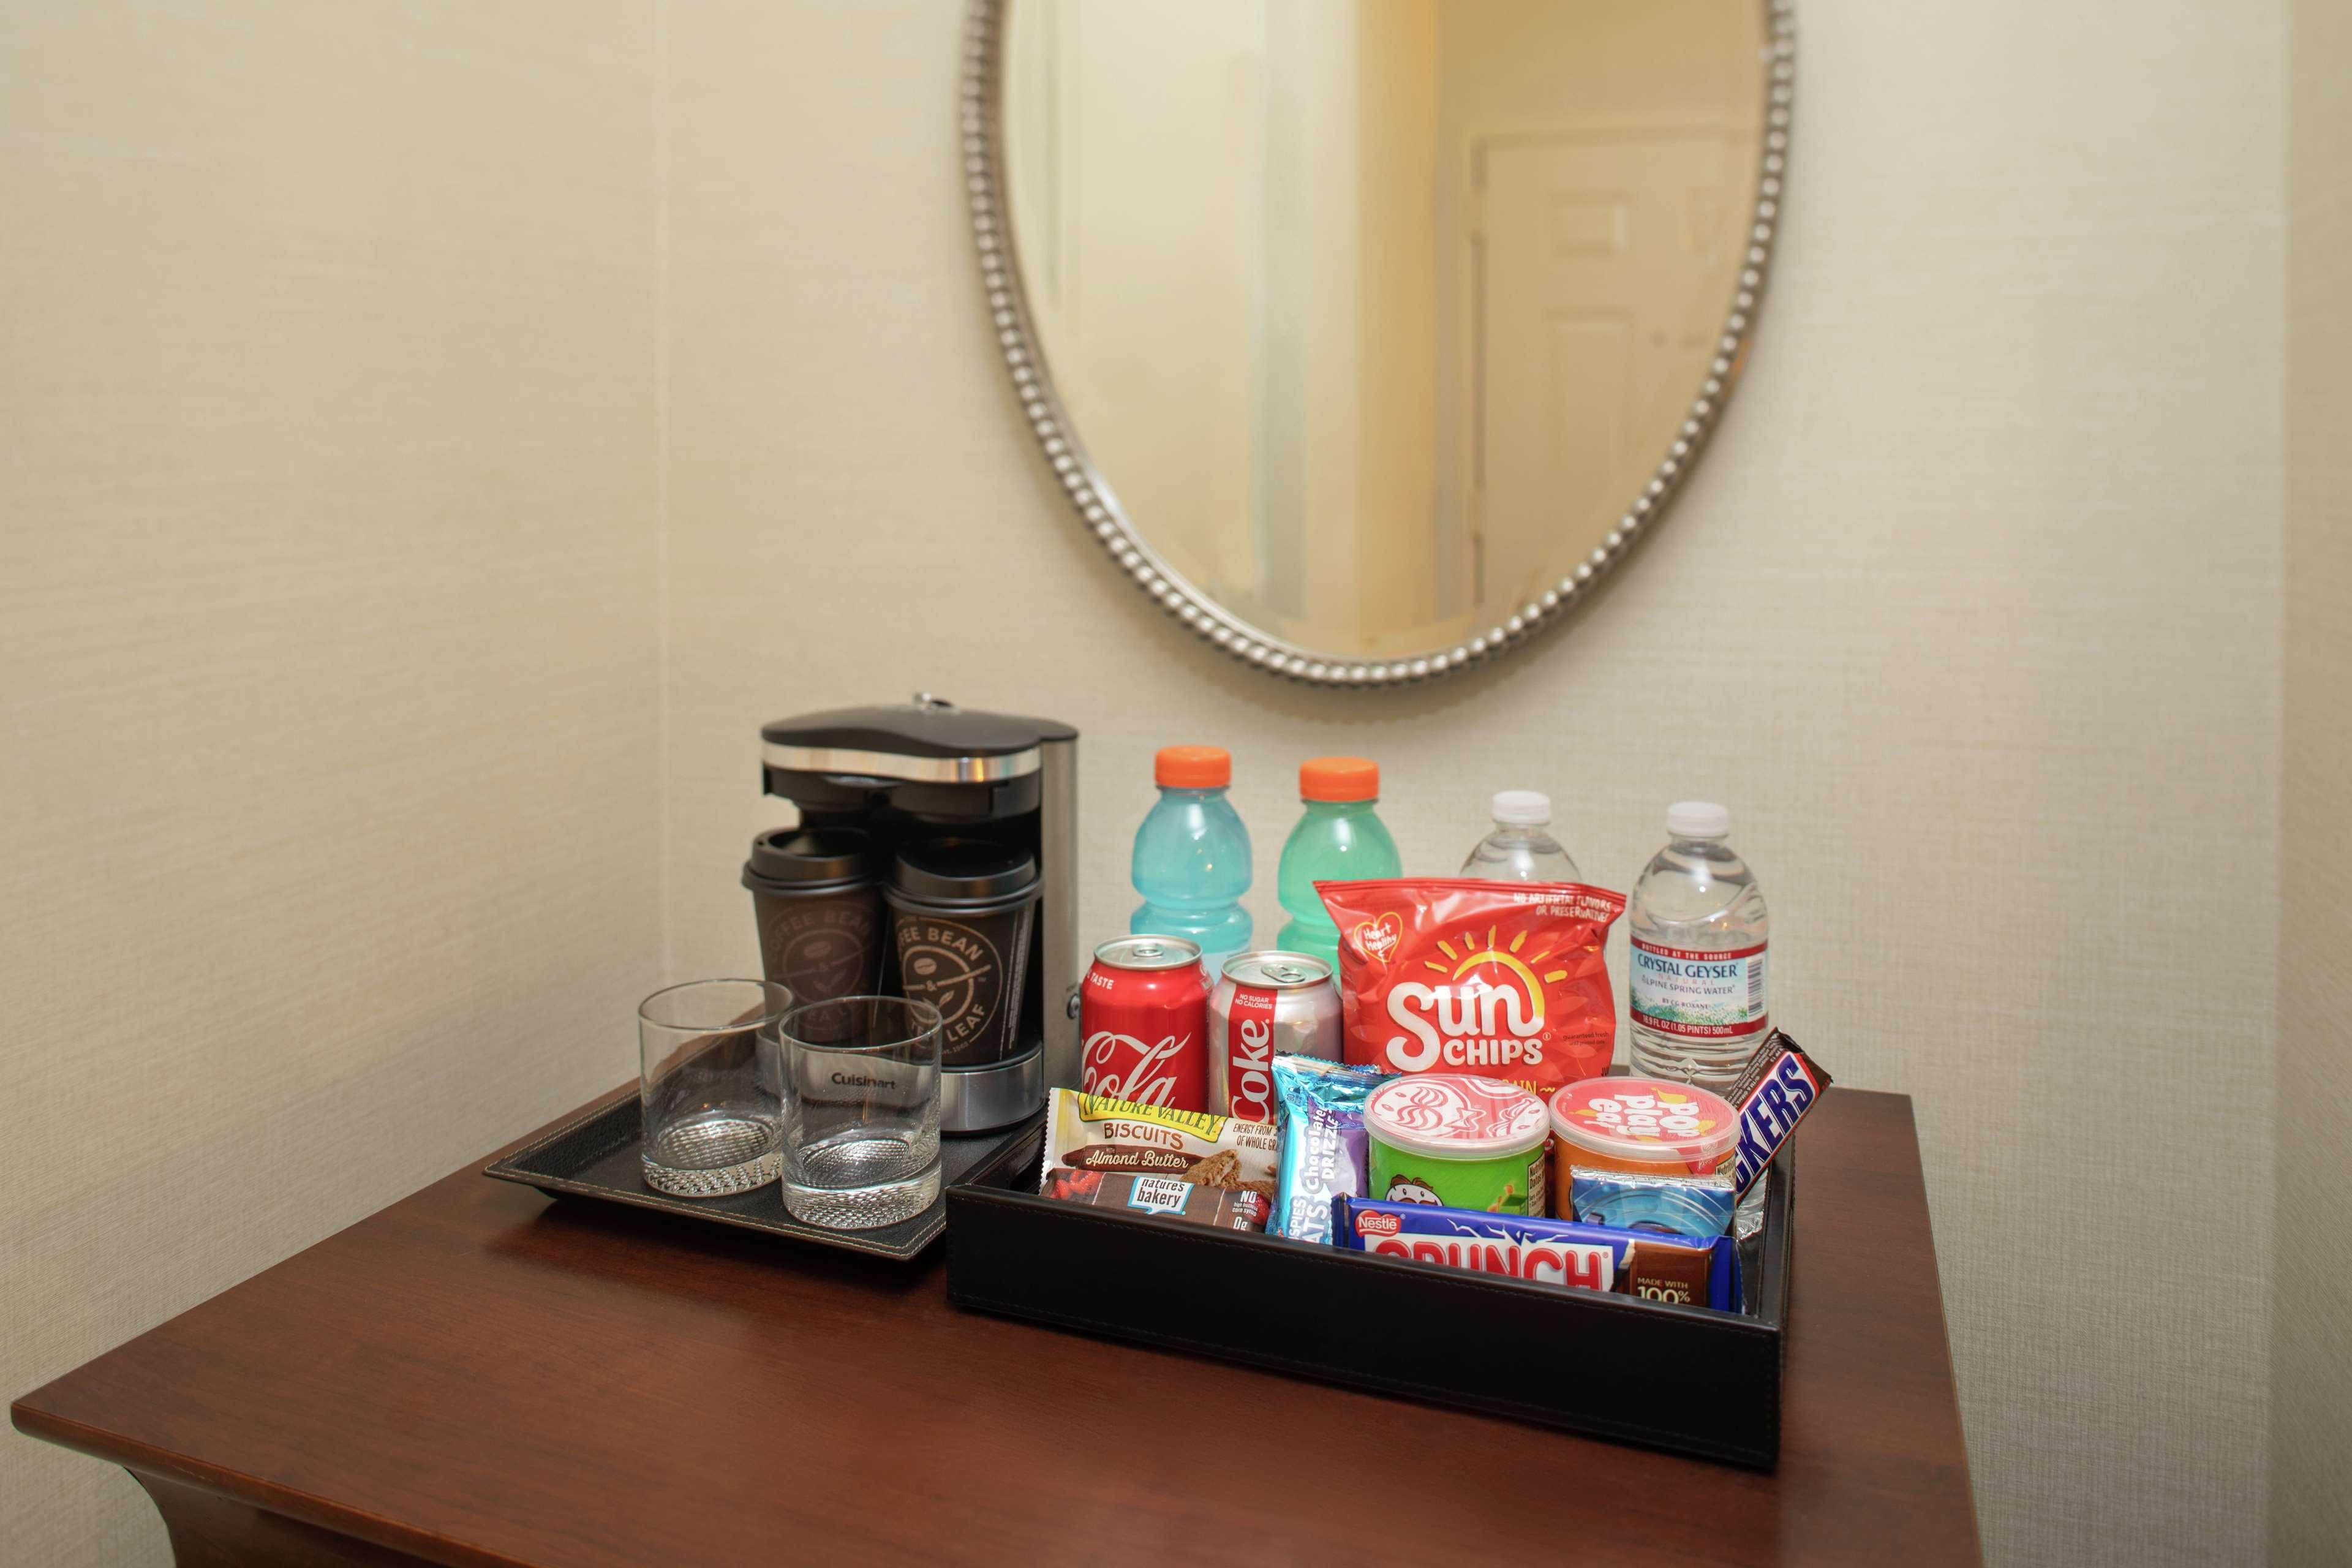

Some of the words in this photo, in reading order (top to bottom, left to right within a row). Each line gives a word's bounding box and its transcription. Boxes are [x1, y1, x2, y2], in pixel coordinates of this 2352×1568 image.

[1536, 905, 1547, 916] OR
[1363, 922, 1392, 940] Heart
[927, 927, 983, 961] BEAN
[1642, 943, 1668, 956] BOTTLED
[1638, 954, 1682, 976] CRYSTAL
[1685, 964, 1737, 978] GEYSER
[1090, 972, 1114, 990] TASTE
[1642, 974, 1667, 989] ALPINE
[1669, 984, 1702, 995] SPRING
[1659, 973, 1714, 986] NATURAL
[1244, 1000, 1272, 1009] CALORIES
[947, 1004, 985, 1042] LEAF
[1385, 981, 1545, 1072] Sun
[1654, 1018, 1661, 1027] FL
[1662, 1020, 1670, 1029] OZ
[1671, 1023, 1686, 1033] (1.05
[1687, 1026, 1711, 1035] PINTS)
[1563, 1032, 1594, 1041] guaranteed
[1442, 1038, 1543, 1066] CHIPS
[1082, 1031, 1191, 1108] Cola
[1231, 1019, 1270, 1125] Coke
[832, 1072, 896, 1089] Cuisinart
[1084, 1093, 1152, 1116] NATURE
[1158, 1106, 1221, 1136] VALLEY
[1614, 1094, 1663, 1136] play
[1657, 1101, 1702, 1137] pop
[1104, 1123, 1184, 1150] BISCUITS
[1233, 1123, 1255, 1134] ENERGY
[1255, 1125, 1272, 1136] FROM
[1237, 1135, 1245, 1146] OF
[1246, 1136, 1267, 1150] WHOLE
[1321, 1115, 1339, 1180] DRIZZLE
[1086, 1150, 1139, 1166] Almond
[1142, 1150, 1188, 1168] Butter
[1137, 1186, 1181, 1208] bakery
[1240, 1190, 1257, 1204] NO
[1243, 1208, 1257, 1217] syrup
[1233, 1216, 1248, 1231] 0g
[1375, 1239, 1600, 1292] UNCH
[1637, 1277, 1661, 1287] MADE
[1664, 1280, 1688, 1289] WITH
[1637, 1286, 1691, 1304] 100%
